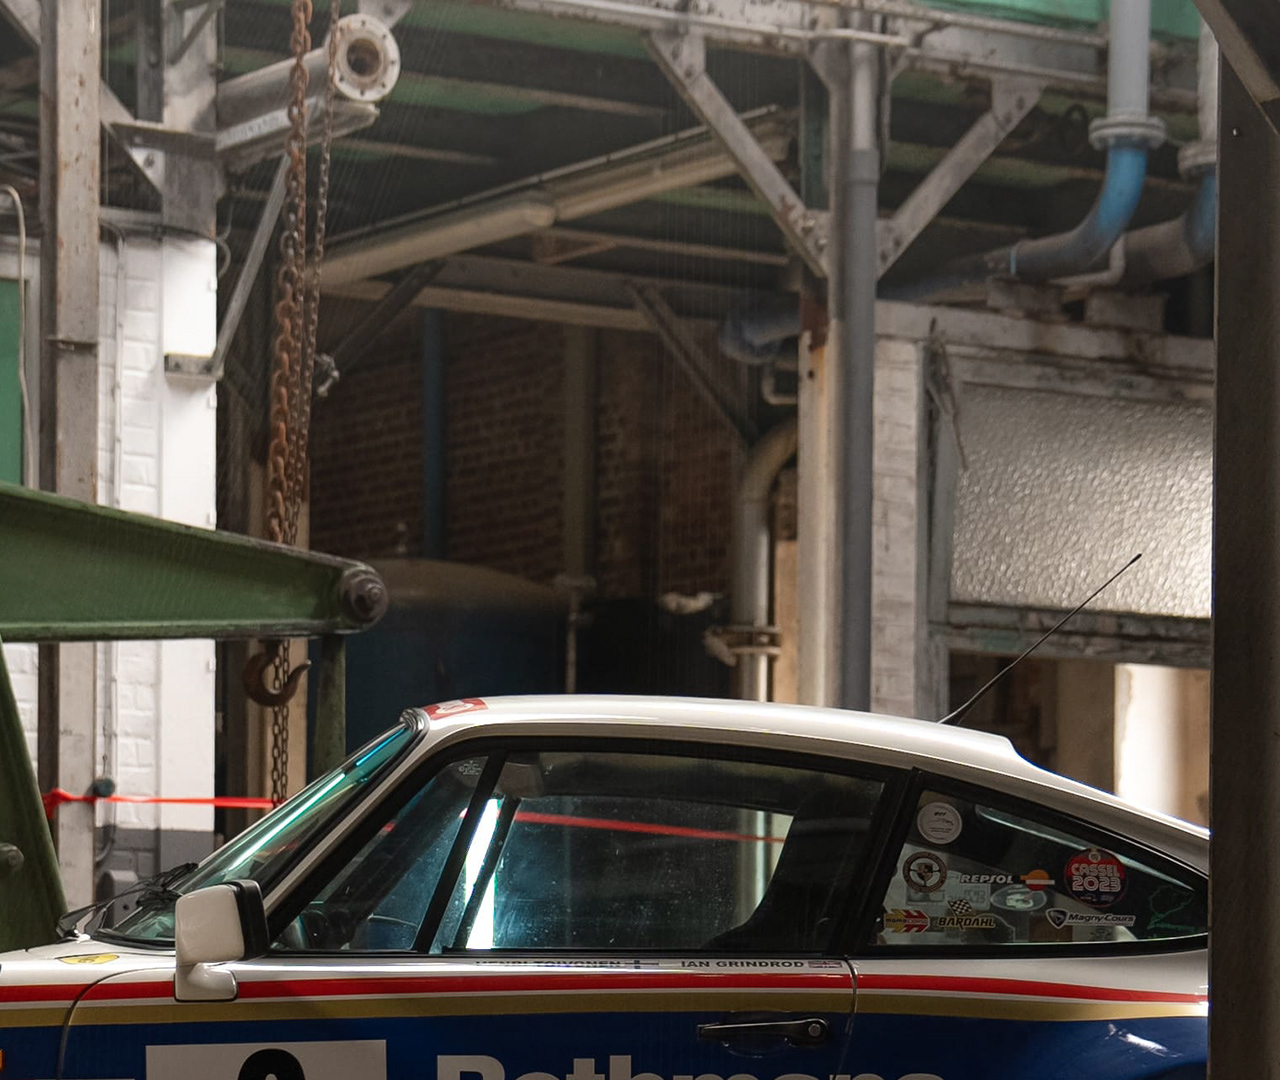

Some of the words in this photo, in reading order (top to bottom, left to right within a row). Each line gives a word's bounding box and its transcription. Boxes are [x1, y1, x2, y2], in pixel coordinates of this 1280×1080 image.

[1071, 863, 1121, 877] CASSEL
[960, 874, 1014, 884] REPSOL
[1072, 876, 1122, 892] 2023
[938, 917, 995, 928] BARDAHL
[1068, 913, 1134, 923] Magny-Cours
[681, 960, 710, 968] IAN
[716, 960, 805, 968] GRINDROD
